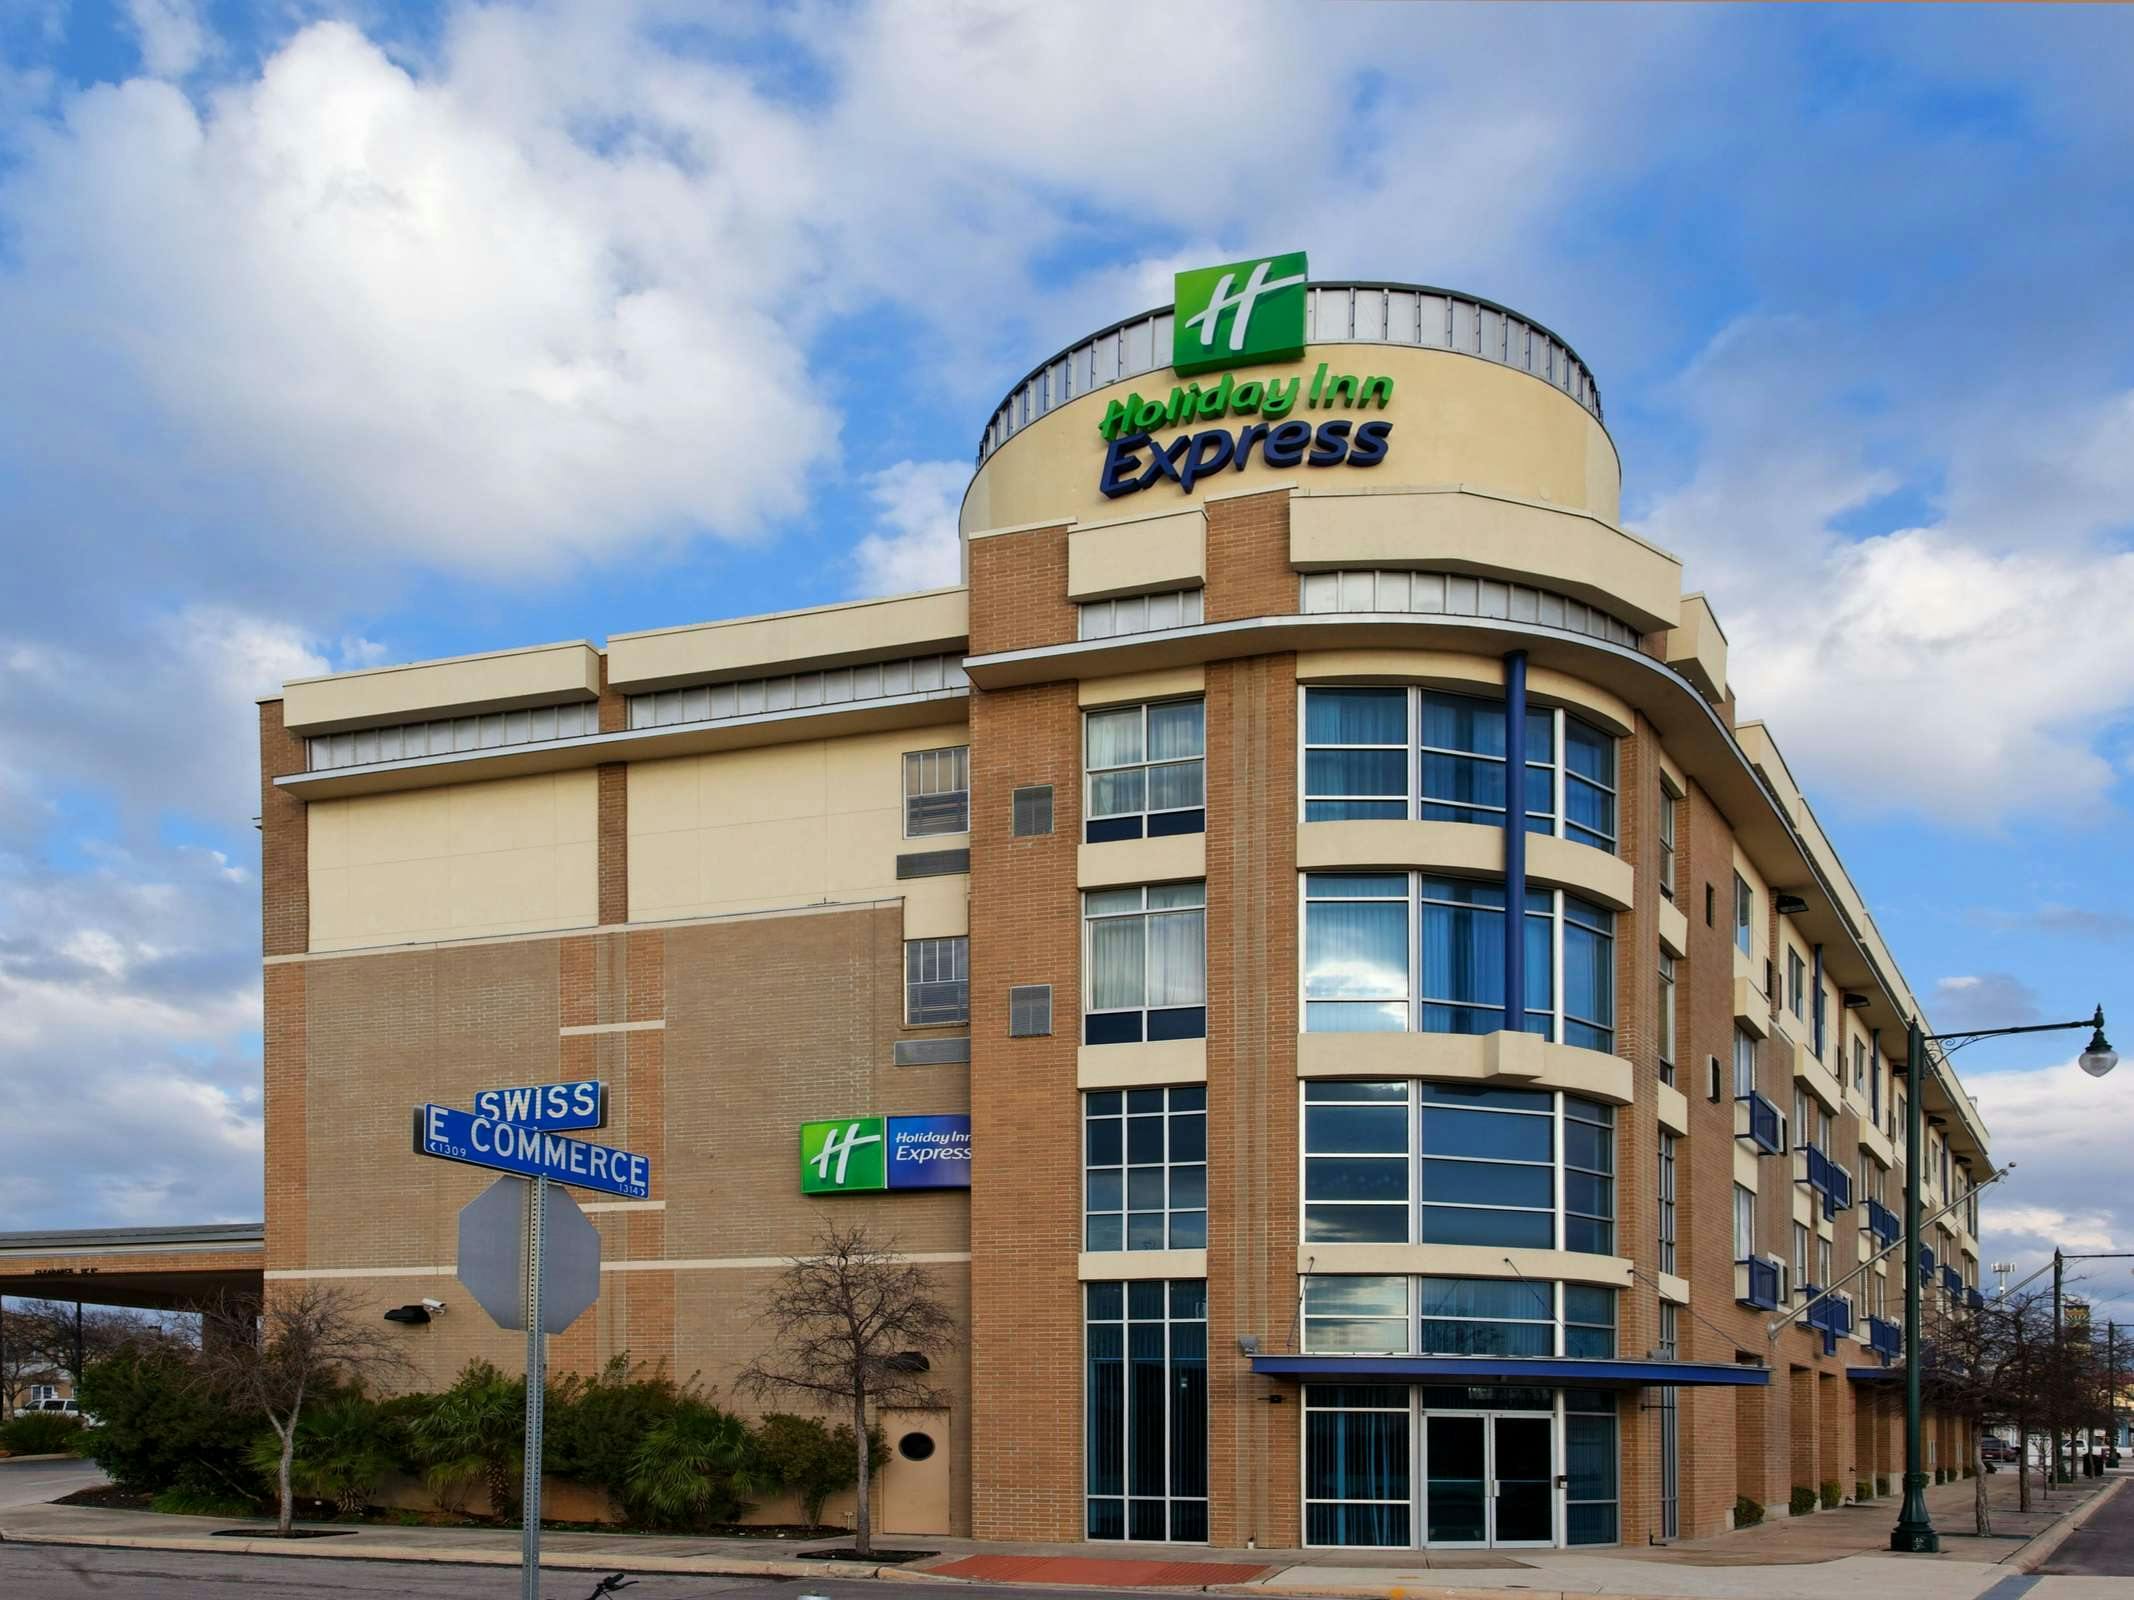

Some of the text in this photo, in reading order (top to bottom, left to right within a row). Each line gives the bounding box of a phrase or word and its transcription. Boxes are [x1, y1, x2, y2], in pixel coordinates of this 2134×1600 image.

[1098, 363, 1394, 441] Holiday Inn
[1100, 420, 1393, 499] Express
[480, 1083, 595, 1121] SWISS
[429, 1106, 646, 1188] E COMMERCE
[440, 1142, 467, 1157] 1309
[896, 1131, 950, 1145] Holiday
[896, 1145, 972, 1164] Express
[620, 1184, 639, 1195] 1314
